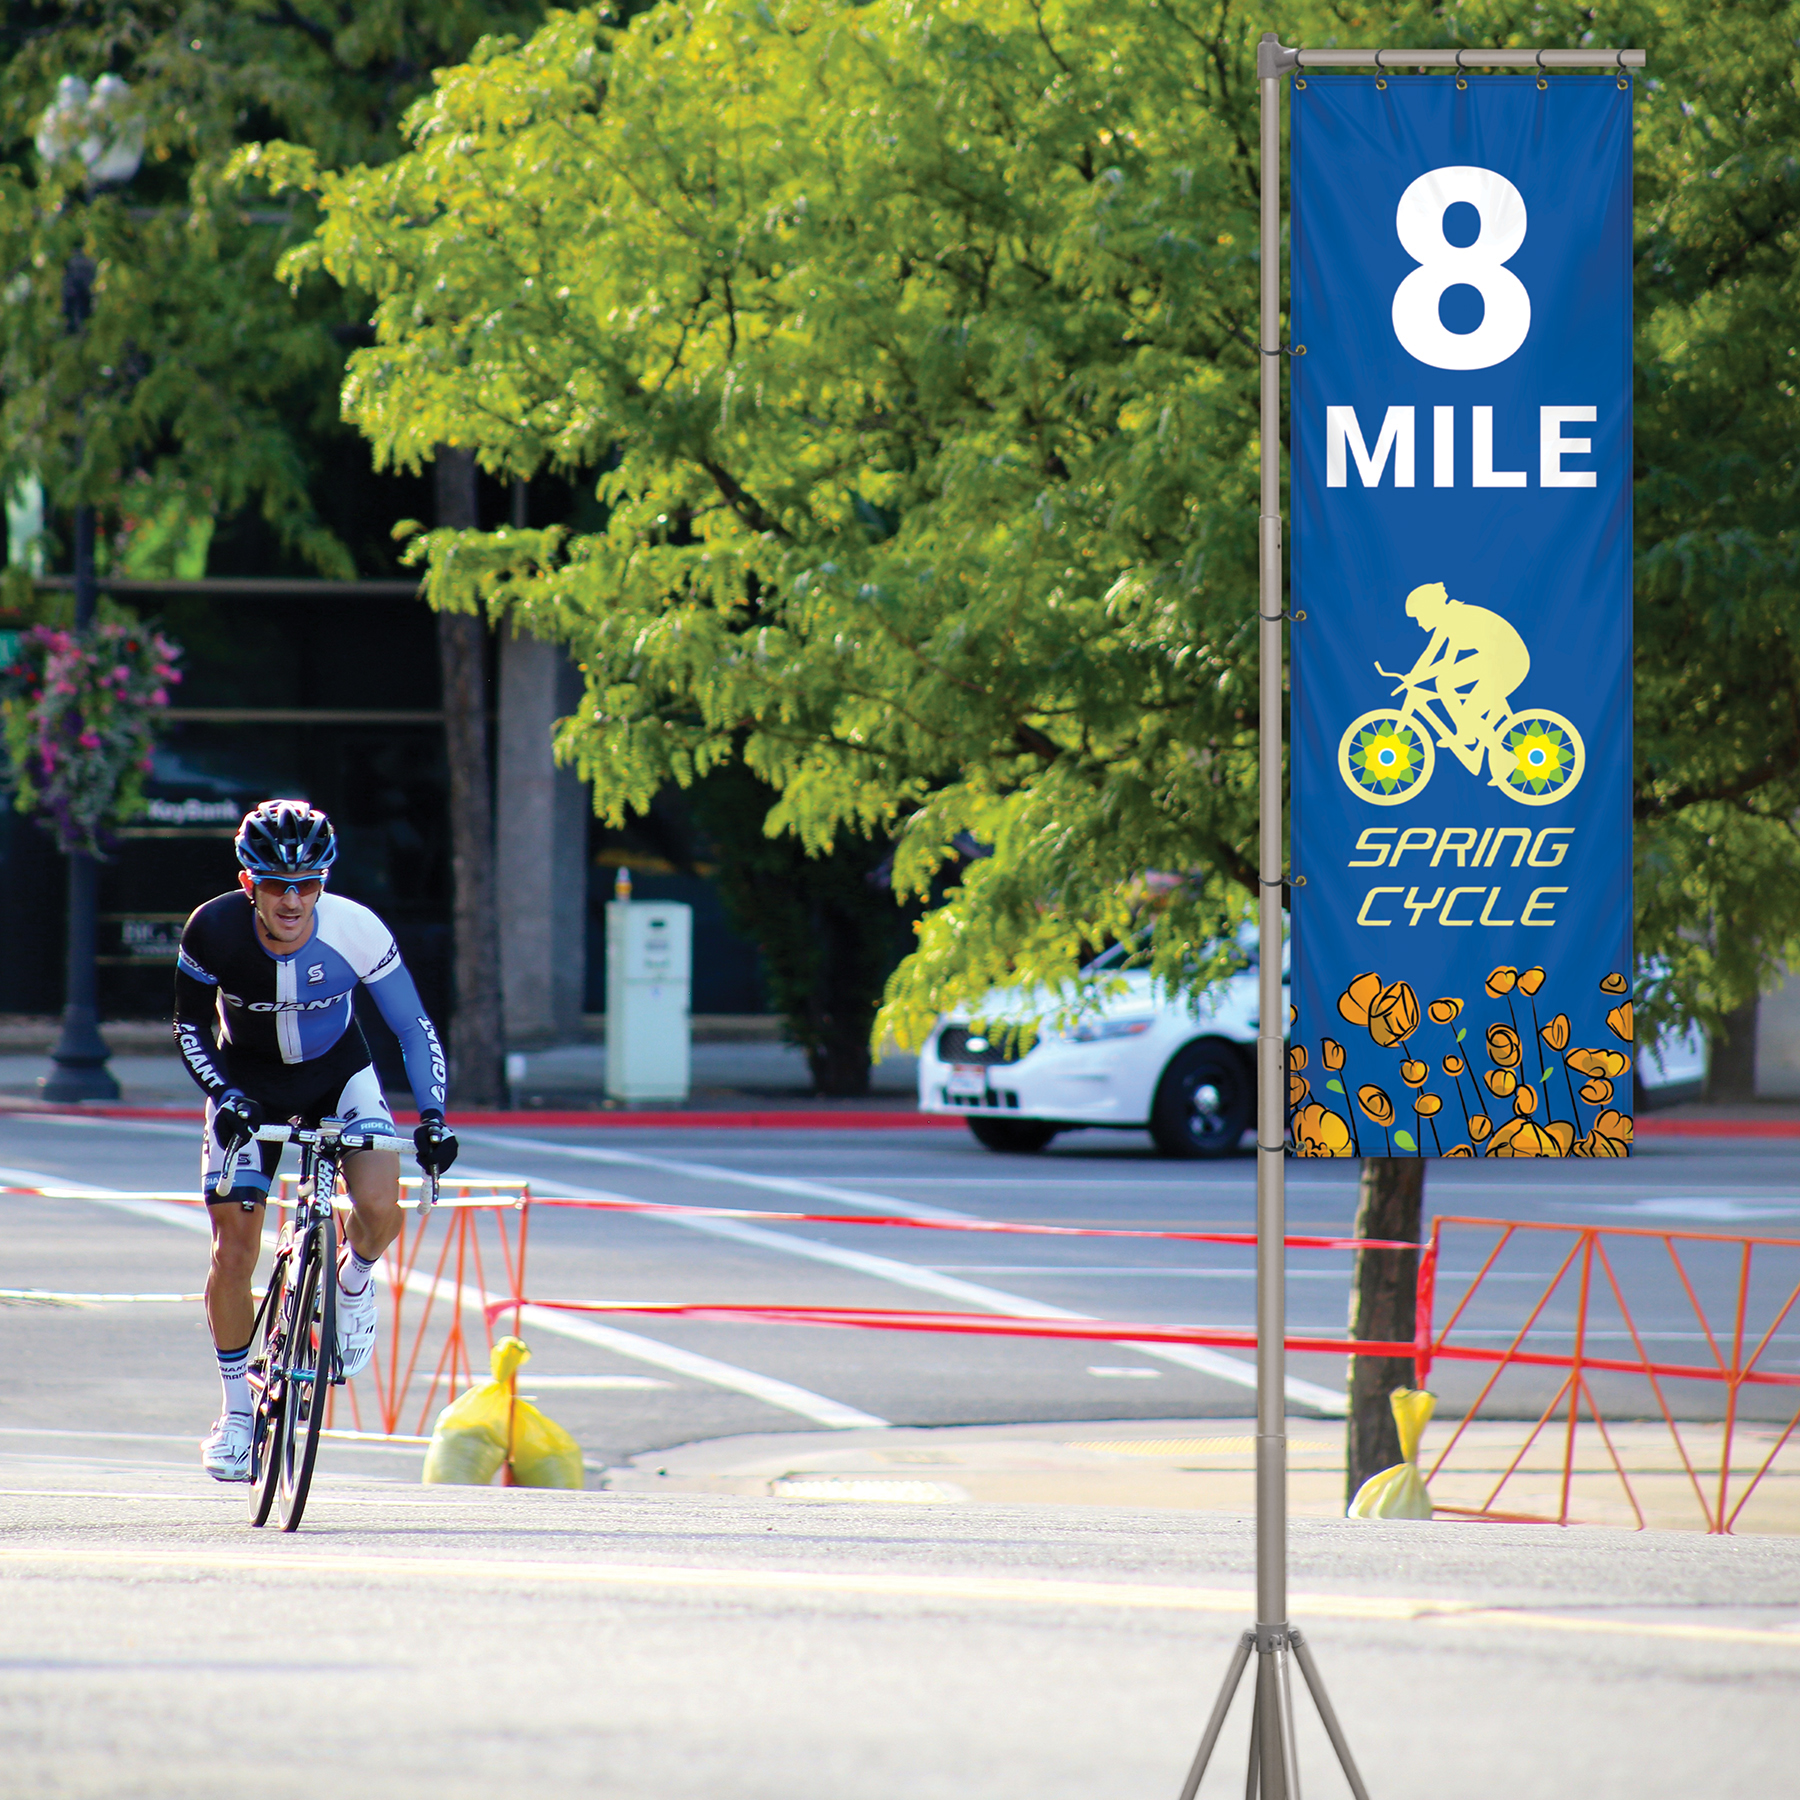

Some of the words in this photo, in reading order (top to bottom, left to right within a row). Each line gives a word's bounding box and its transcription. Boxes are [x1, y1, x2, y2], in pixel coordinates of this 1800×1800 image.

[1391, 165, 1531, 371] 8
[1326, 405, 1597, 488] MILE
[147, 799, 239, 824] KeyBank
[1347, 827, 1576, 867] SPRING
[1356, 886, 1570, 927] CYCLE
[247, 990, 348, 1012] GIANT
[180, 1033, 225, 1089] GIANT
[417, 1017, 446, 1085] GIANT
[360, 1121, 383, 1131] RIDE
